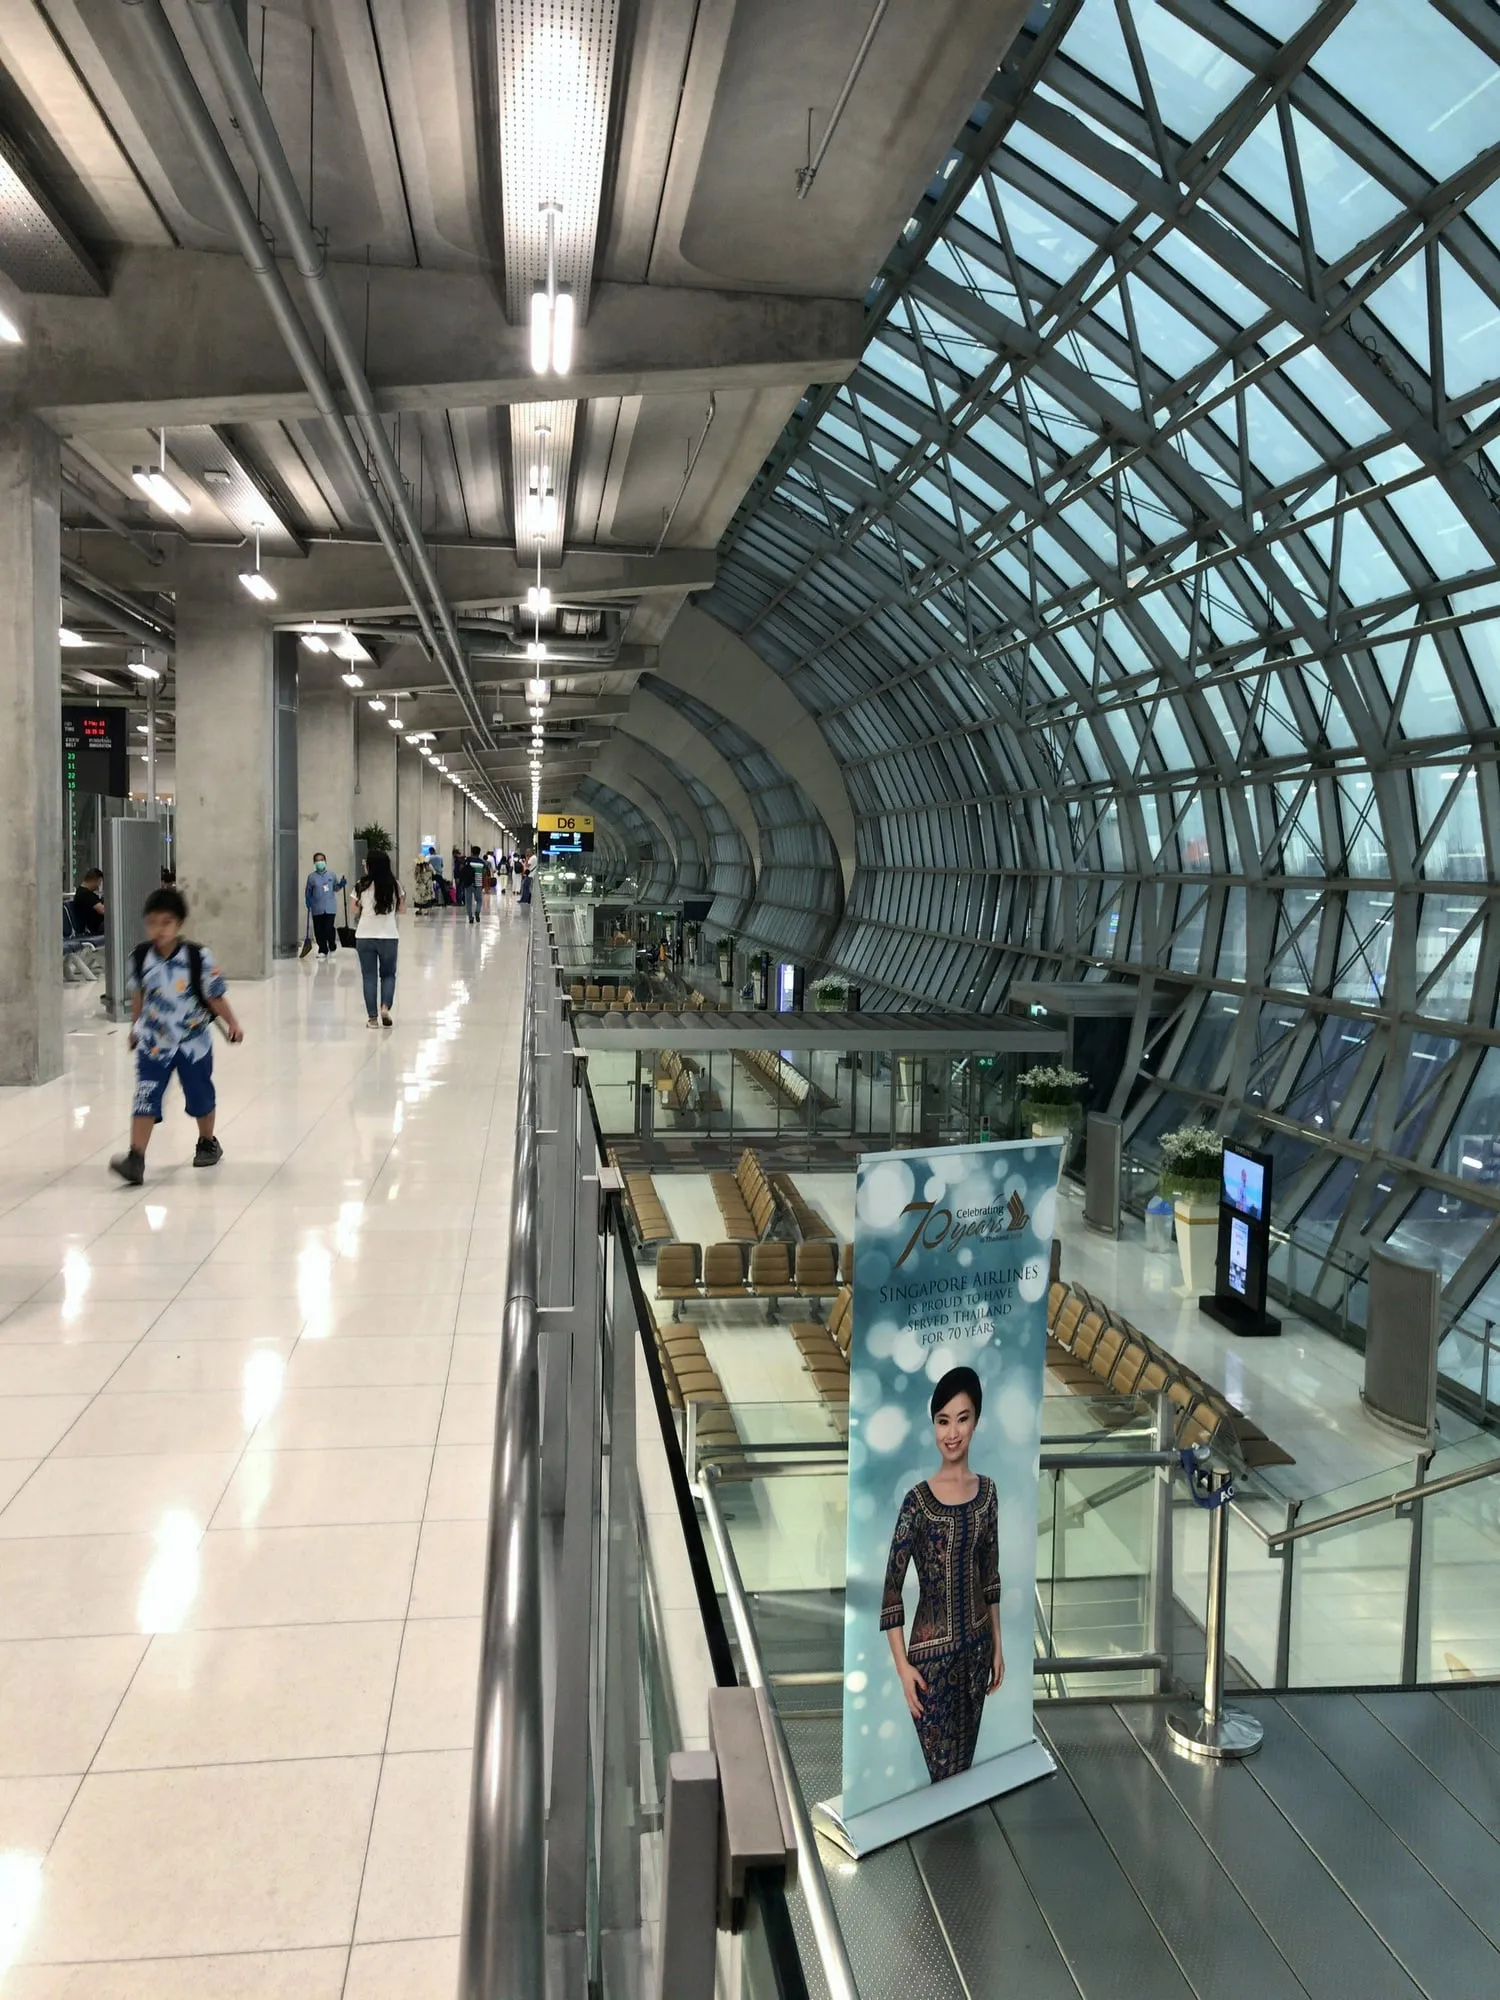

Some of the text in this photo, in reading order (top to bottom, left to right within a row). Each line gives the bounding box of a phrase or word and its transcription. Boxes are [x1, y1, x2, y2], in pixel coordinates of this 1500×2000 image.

[557, 817, 576, 829] D6
[893, 1199, 1004, 1269] 70 Celebrating
[947, 1218, 1004, 1253] years
[879, 1264, 1039, 1304] SINGAPORE AIRLINES
[907, 1287, 1013, 1316] IS PROUD TO HAVE
[907, 1303, 1012, 1332] SERVED THAILAND
[921, 1322, 996, 1345] FOR 70 YEARS
